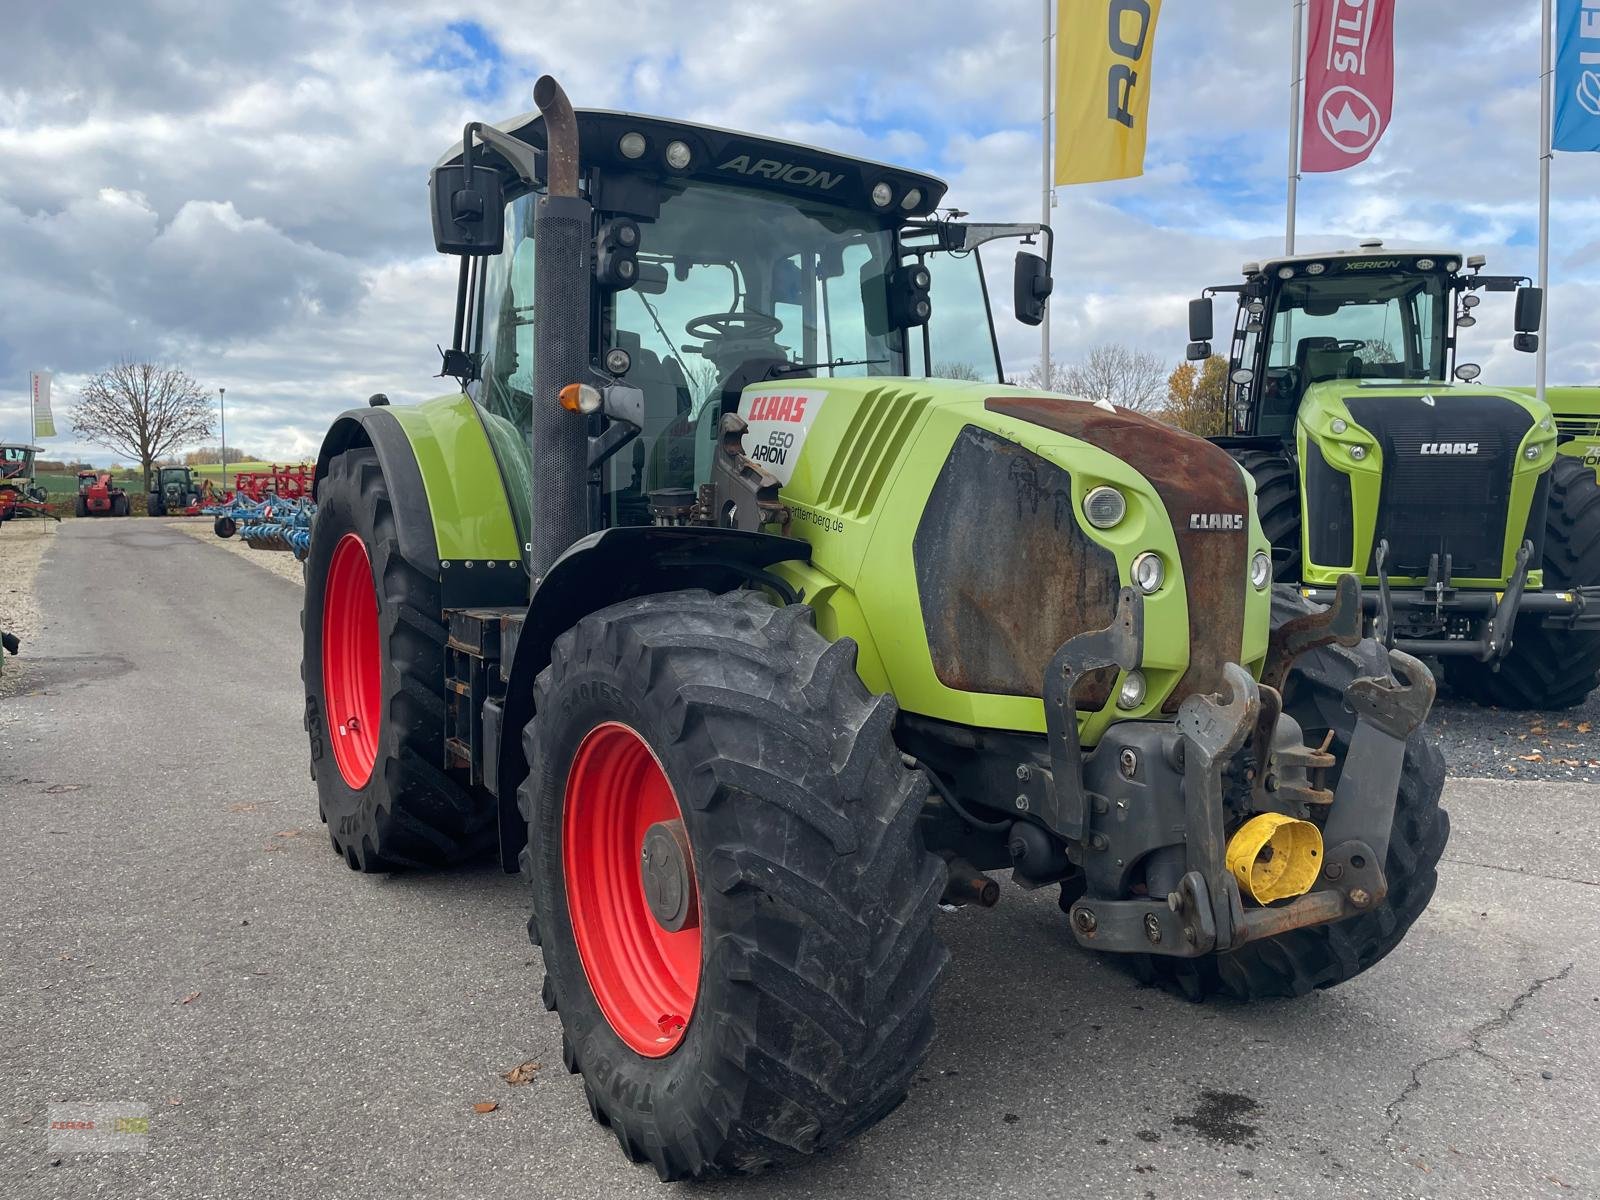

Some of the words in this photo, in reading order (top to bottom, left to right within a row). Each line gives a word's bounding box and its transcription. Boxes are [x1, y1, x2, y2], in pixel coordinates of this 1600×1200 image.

[1333, 0, 1364, 75] SIL
[716, 155, 846, 190] ARION
[1344, 260, 1401, 271] XERION
[748, 395, 809, 423] CLAAS
[768, 430, 794, 449] 650
[1420, 442, 1479, 456] CLAAS
[751, 445, 788, 466] ARION
[1189, 513, 1244, 530] CLAAS
